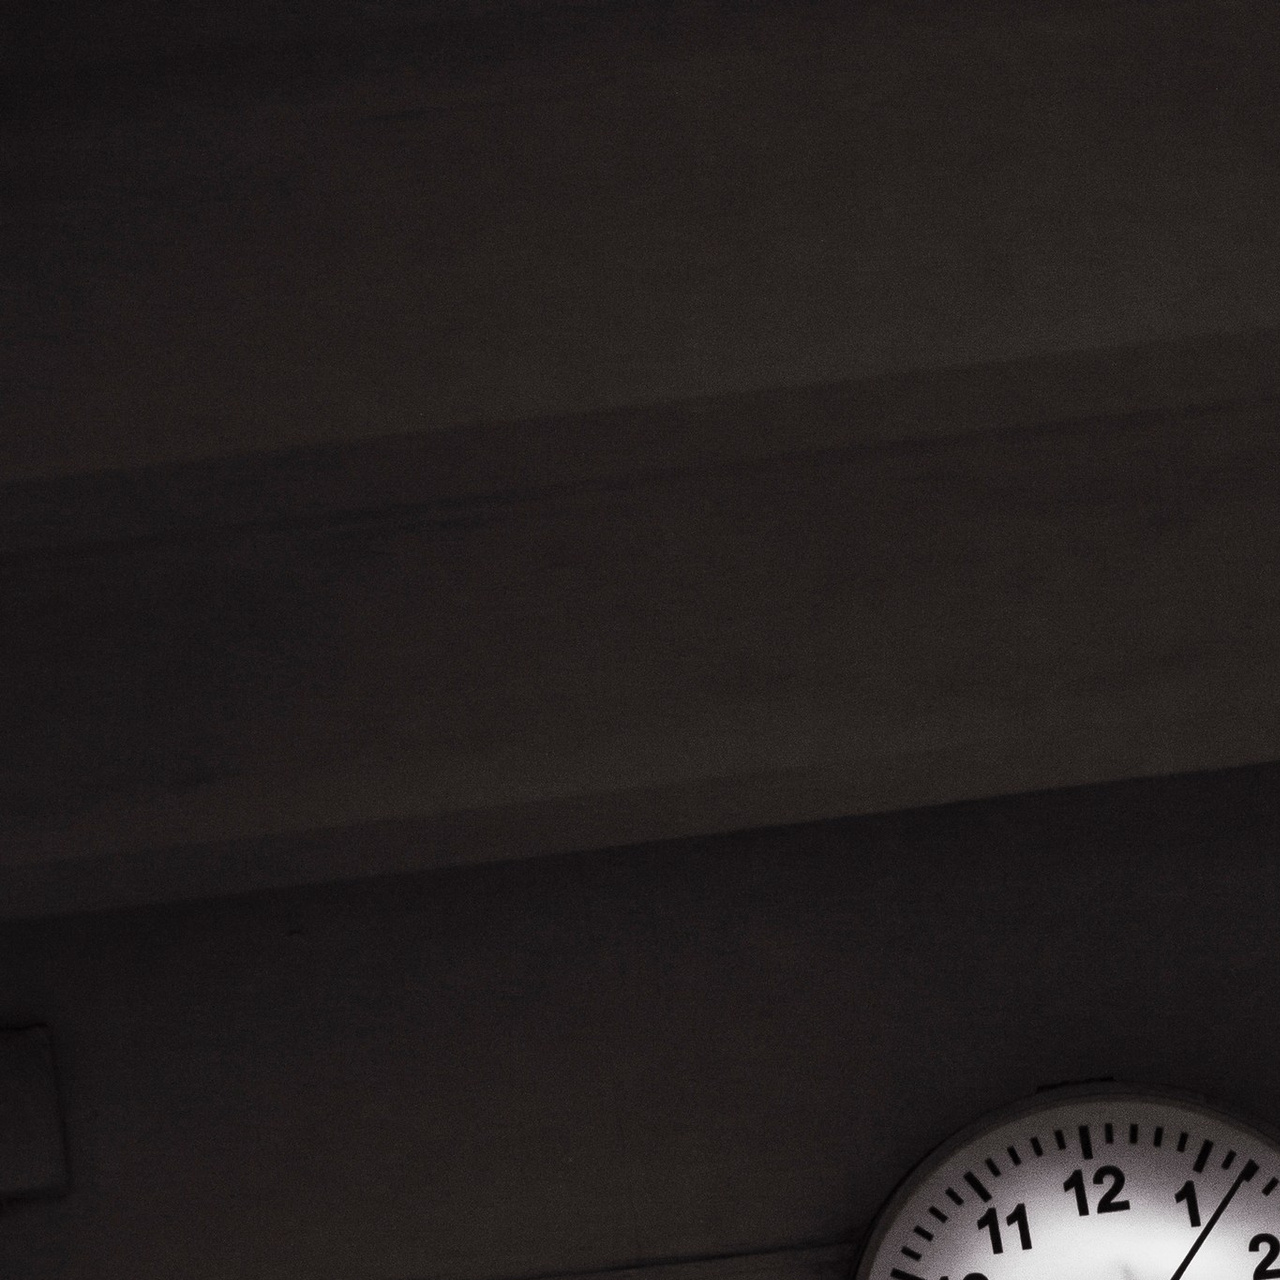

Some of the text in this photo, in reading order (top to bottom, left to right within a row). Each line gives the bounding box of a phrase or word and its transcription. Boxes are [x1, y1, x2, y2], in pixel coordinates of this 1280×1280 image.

[1062, 1165, 1130, 1216] 12
[1174, 1179, 1201, 1227] 1
[976, 1203, 1032, 1255] 11
